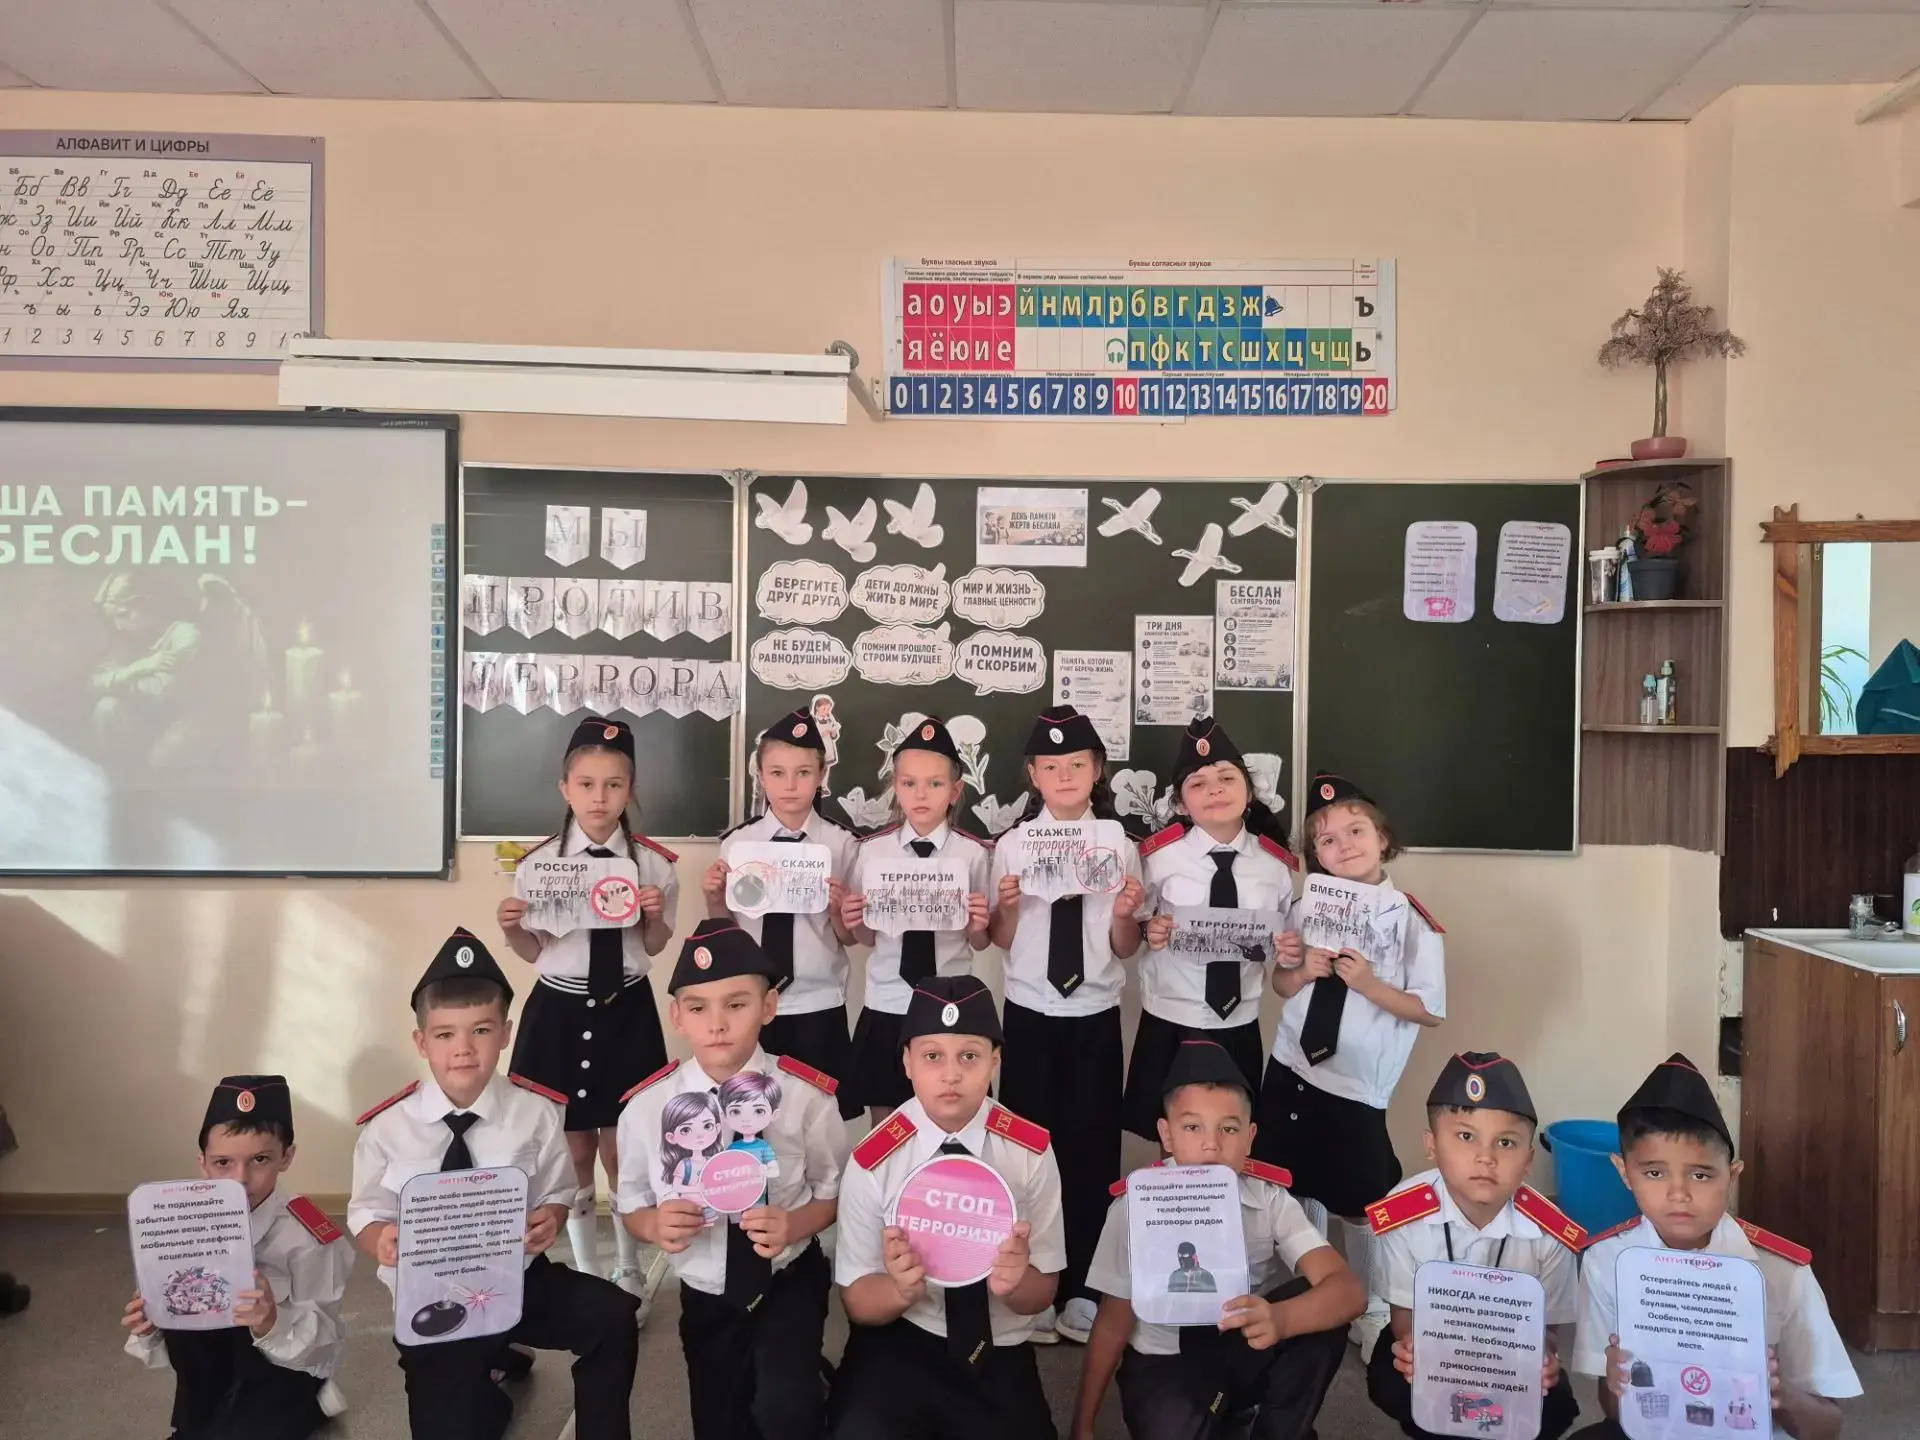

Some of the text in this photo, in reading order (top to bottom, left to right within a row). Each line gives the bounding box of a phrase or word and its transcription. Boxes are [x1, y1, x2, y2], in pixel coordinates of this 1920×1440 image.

[56, 138, 210, 153] АЛФАВИТ И ЦИФРЫ
[60, 176, 91, 198] Вв
[208, 179, 231, 200] Ее
[921, 258, 943, 266] Буквы
[1128, 260, 1150, 268] Буквы
[1152, 260, 1187, 268] согласных
[895, 384, 1386, 410] 0 1 2 3 4 5 6 7 8 9 10 11 12 13 14 15 16 17 18 19 20
[1011, 511, 1057, 522] ДЕНЬ ПАМЯТИ
[1008, 520, 1061, 531] ЖЕРТВ БЕСЛАНА
[774, 577, 838, 593] БЕРЕГИТЕ
[865, 579, 939, 596] ДЕТИ ДОЛЖНЫ
[962, 582, 1030, 595] МИР И ЖИЗНЬ
[1230, 585, 1282, 598] БЕСЛАН
[469, 584, 723, 620] ПРОТИВ
[766, 589, 841, 608] ДРУГ ДРУГА
[865, 593, 939, 609] ЖИТЬ В МИРЕ
[963, 597, 1036, 607] ГЛАВНЫЕ ЦЕННОСТИ
[1147, 621, 1182, 632] ТРИ ДНЯ
[773, 639, 831, 652] НЕ БУДЕМ
[861, 642, 936, 653] ПОМНИМ ПРОШЛОЕ
[970, 644, 1033, 659] ПОМНИМ
[758, 652, 846, 666] РАВНОДУШНЫМИ
[863, 652, 942, 665] СТРОИМ БУДУЩЕЕ
[964, 658, 1037, 673] И СКОРБИМ
[472, 662, 734, 699] ТЕРРОРА
[1028, 828, 1081, 837] СКАЖЕМ
[1022, 840, 1086, 856] терроризму
[534, 863, 588, 871] РОССИЯ
[782, 860, 824, 868] СКАЖИ
[540, 871, 580, 890] против
[881, 873, 954, 881] ТЕРРОРИЗМ
[1310, 884, 1358, 901] ВМЕСТЕ
[1314, 901, 1352, 919] против
[1190, 921, 1265, 930] ТЕРРОРИЗМ
[713, 1165, 751, 1180] СТОП
[1135, 1184, 1184, 1192] Обращайте
[168, 1198, 224, 1209] поднимайте
[411, 1194, 437, 1203] Будьте
[925, 1189, 994, 1216] СТОП
[1152, 1193, 1225, 1202] подозрительные
[406, 1204, 458, 1214] остерегайтесь
[460, 1201, 484, 1210] людей
[135, 1210, 244, 1224] забытые посторонними
[444, 1212, 460, 1220] Если
[1146, 1218, 1223, 1227] разговоры рядом
[141, 1222, 241, 1237] людьми вещи, сумки,
[898, 1215, 1005, 1245] ТЕРРОРИЗМ
[140, 1239, 194, 1249] мобильные
[416, 1237, 440, 1245] куртку
[158, 1251, 204, 1261] кошельки
[402, 1248, 438, 1257] особенно
[1655, 1255, 1723, 1268] АНТИТЕРРОР
[1452, 1269, 1513, 1282] АНТИТЕРРОР
[1640, 1274, 1700, 1288] Остерегайтесь
[1702, 1282, 1732, 1292] людей
[1428, 1286, 1533, 1308] НИКОГДА не следует
[1645, 1287, 1733, 1304] большими сумками,
[1430, 1302, 1475, 1314] заводить
[1477, 1308, 1522, 1322] разговор
[1640, 1299, 1739, 1317] баулами, чемоданами.
[1444, 1318, 1515, 1334] незнакомыми
[1648, 1312, 1732, 1328] Особенно, если они
[1634, 1323, 1677, 1335] находятся
[1686, 1330, 1748, 1343] неожиданном
[1422, 1330, 1536, 1351] людьми. Необходимо
[1678, 1341, 1704, 1350] месте.
[1454, 1349, 1503, 1361] отвергать
[1440, 1361, 1517, 1377] прикосновения
[1427, 1374, 1528, 1393] незнакомых людей!
